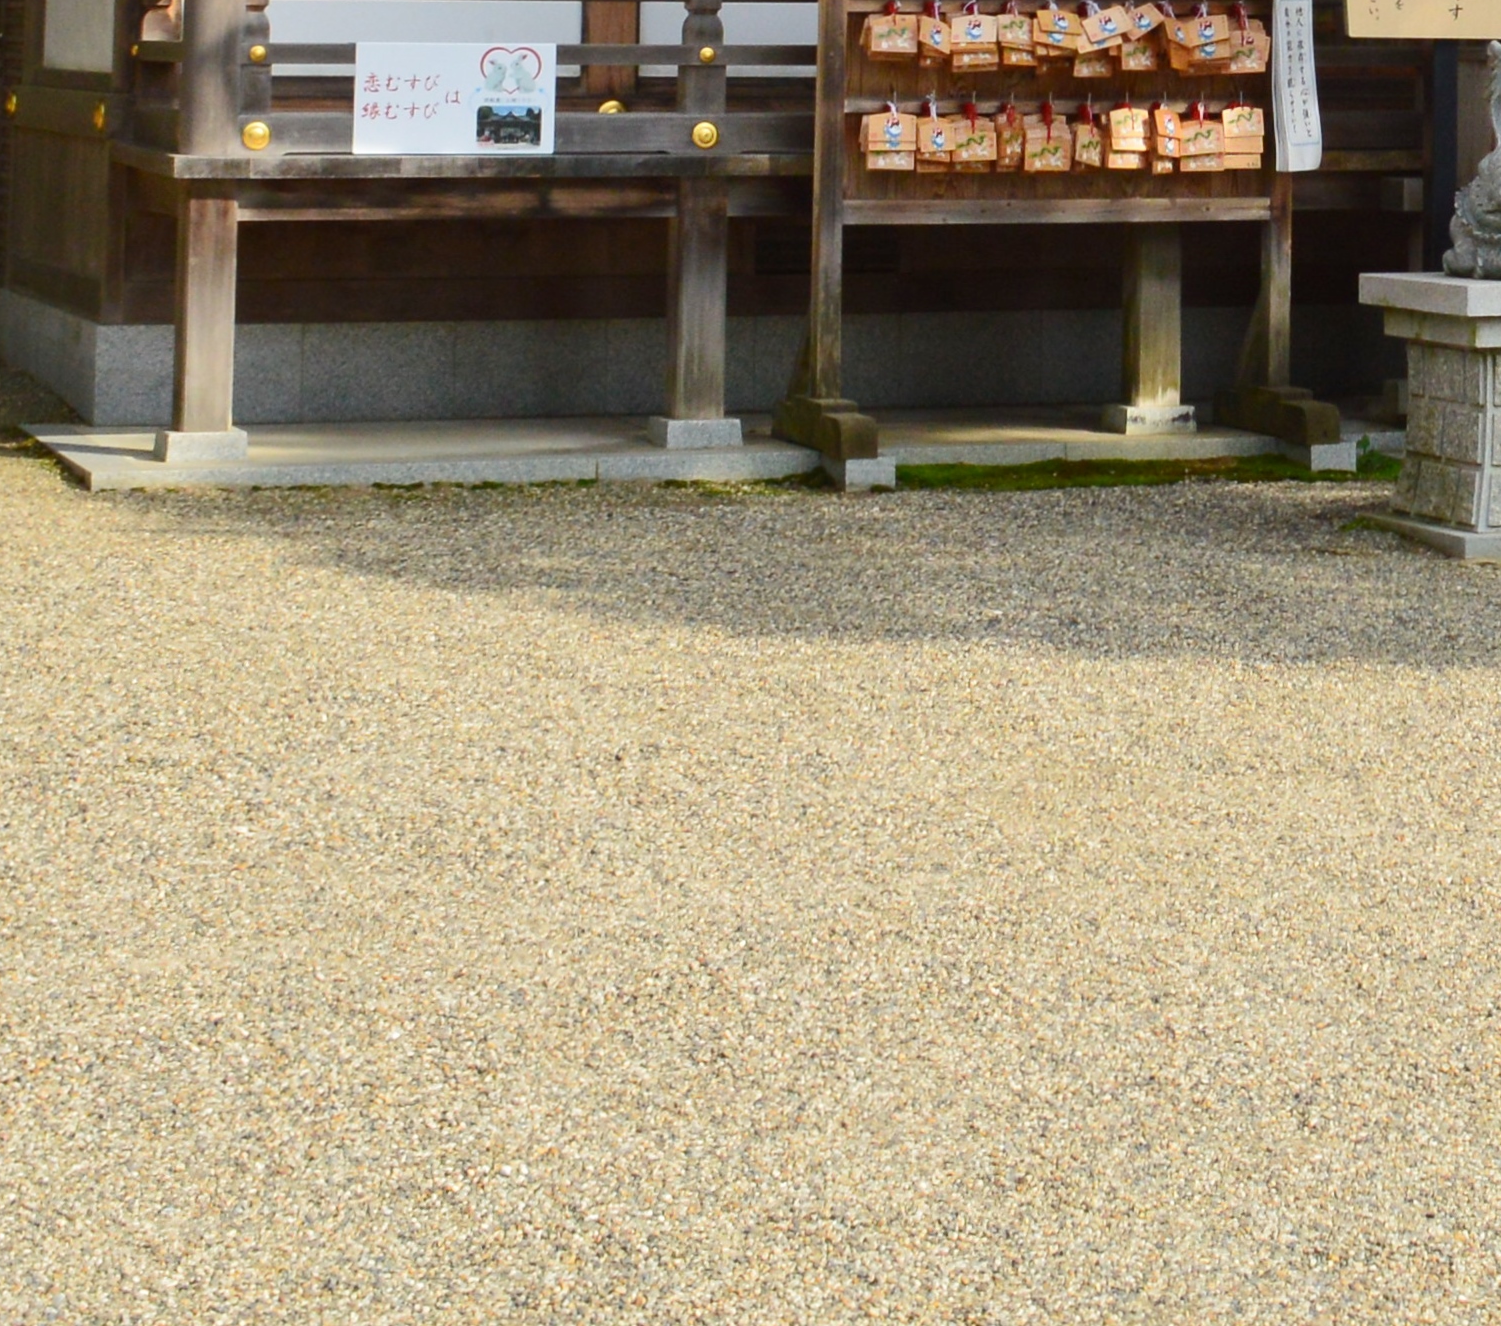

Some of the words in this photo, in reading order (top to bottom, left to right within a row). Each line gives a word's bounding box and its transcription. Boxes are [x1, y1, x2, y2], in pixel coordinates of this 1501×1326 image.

[363, 72, 440, 93] 恋むすび
[445, 90, 461, 105] は
[361, 103, 439, 120] 縁むすび
